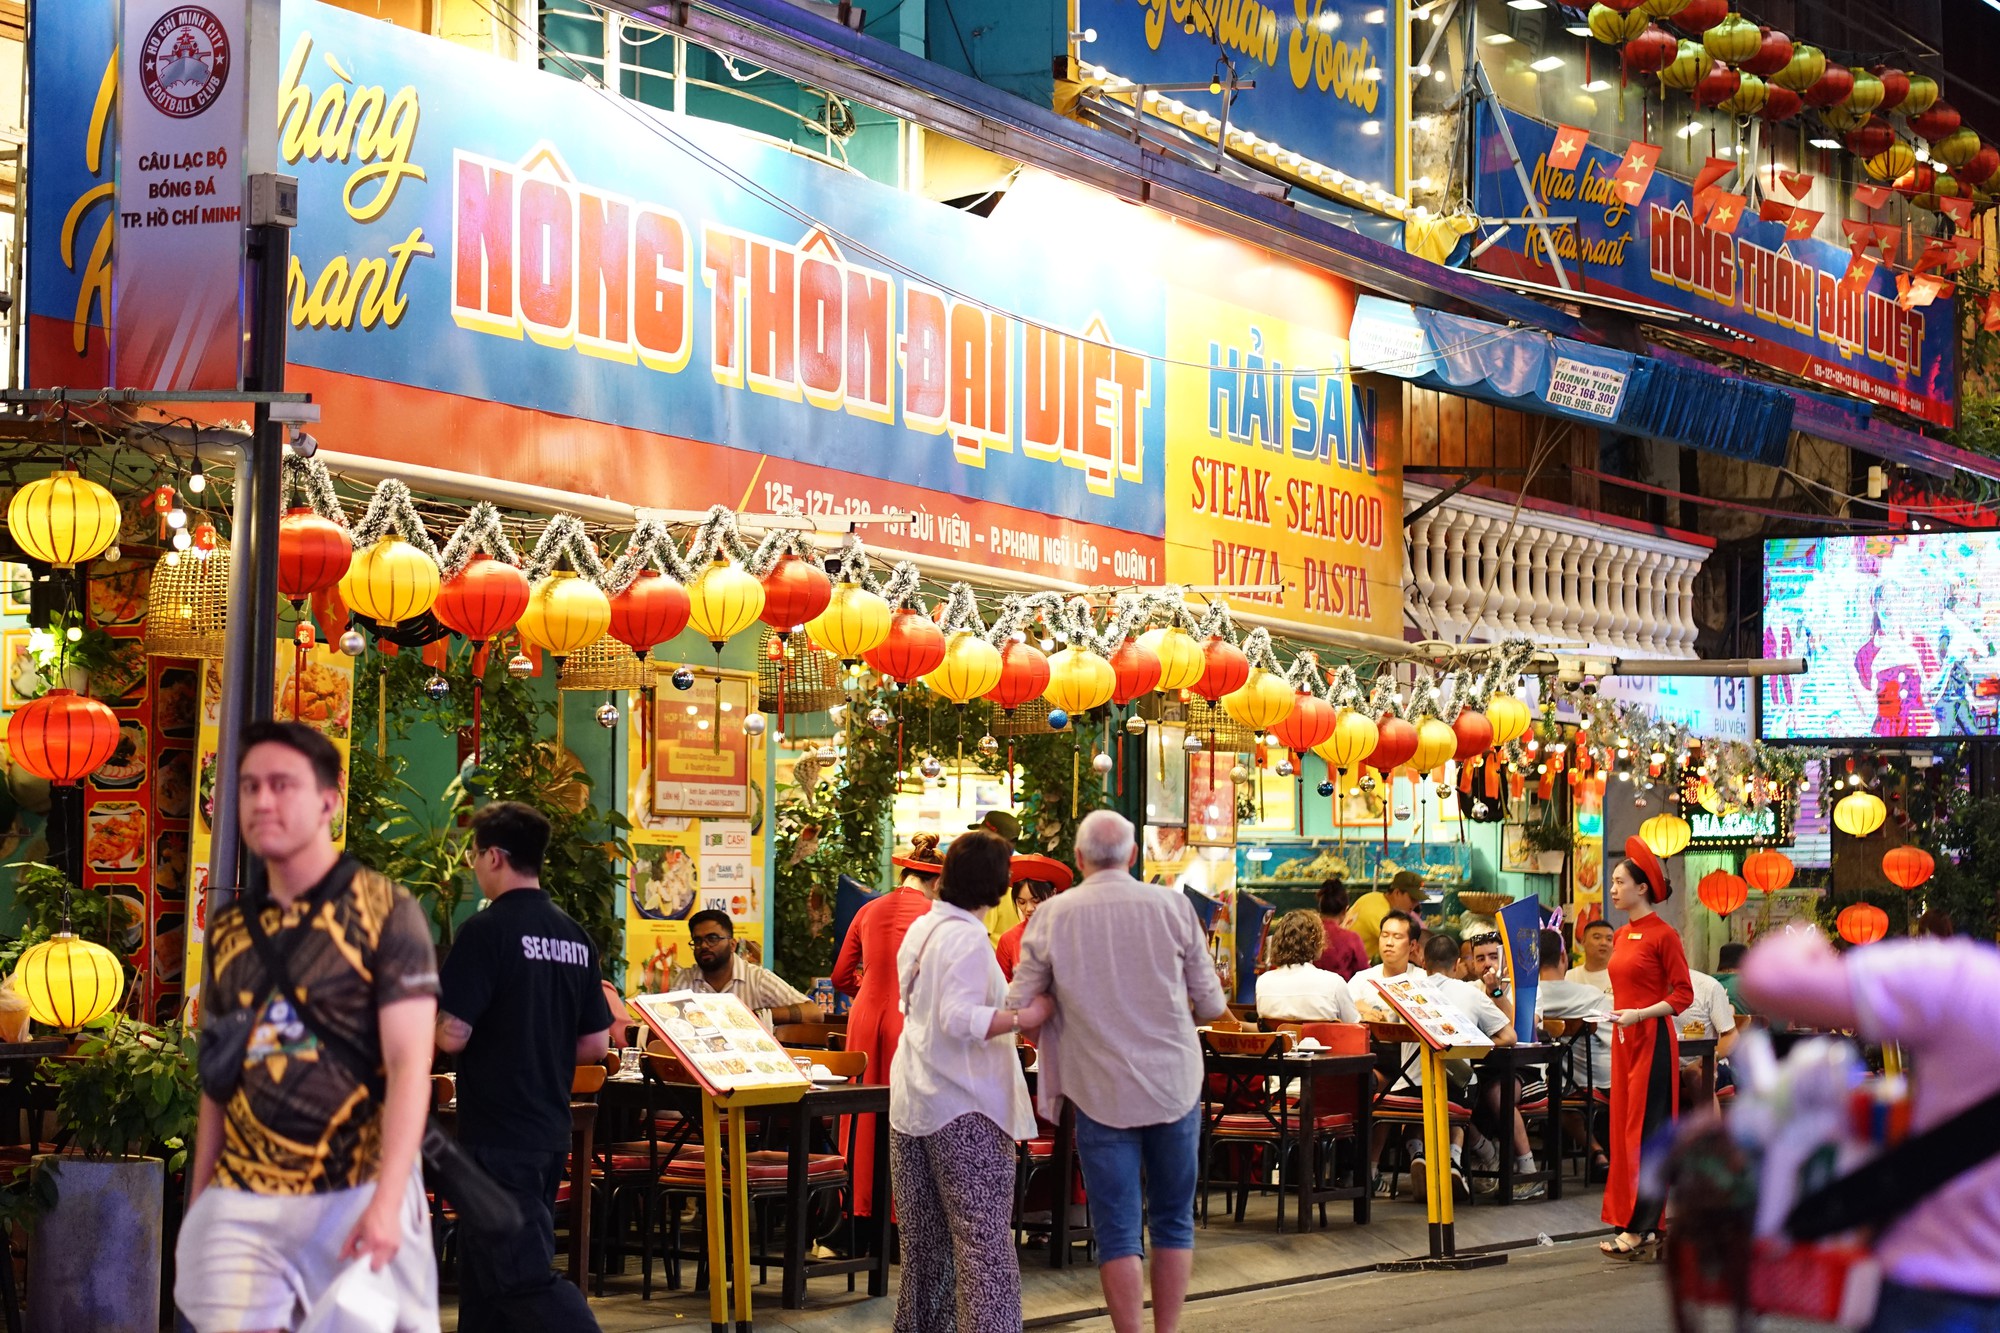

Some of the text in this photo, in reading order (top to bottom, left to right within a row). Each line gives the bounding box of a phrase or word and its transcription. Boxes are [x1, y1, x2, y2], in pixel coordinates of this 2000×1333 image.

[147, 11, 224, 55] HO CHI MINH CITY
[148, 75, 220, 113] FOOTBALL CLUB
[139, 146, 228, 172] CÂU LẠC BỘ
[149, 176, 216, 199] BÓNG ĐÁ
[121, 205, 241, 228] TP. HỒ CHÍ MINH
[1650, 200, 1736, 306] NÔNG
[1738, 242, 1814, 337] THÔN
[1816, 269, 1864, 361] ĐẠI
[451, 139, 693, 373] NÔNG
[701, 220, 895, 424] THÔN
[897, 279, 1014, 469] ĐẠI
[1553, 381, 1616, 405] 0932.166.309
[1555, 370, 1590, 387] THANH
[1208, 327, 1378, 476] HẢI SẢN
[1549, 392, 1612, 416] 0918.995.654
[1191, 455, 1272, 527] STEAK
[1286, 478, 1384, 550] SEAFOOD
[990, 526, 1040, 566] P.PHẠM
[1043, 535, 1070, 568] NGŨ
[1074, 539, 1099, 572] LÃO
[1114, 548, 1147, 584] QUẬN
[1150, 557, 1156, 583] 1
[1212, 539, 1285, 607] PIZZA
[1303, 557, 1373, 622] PASTA
[1713, 676, 1746, 714] 131
[1619, 699, 1701, 729] RTAURANT
[727, 834, 746, 845] CASH
[705, 898, 727, 912] VISA
[521, 935, 589, 968] SECURITY
